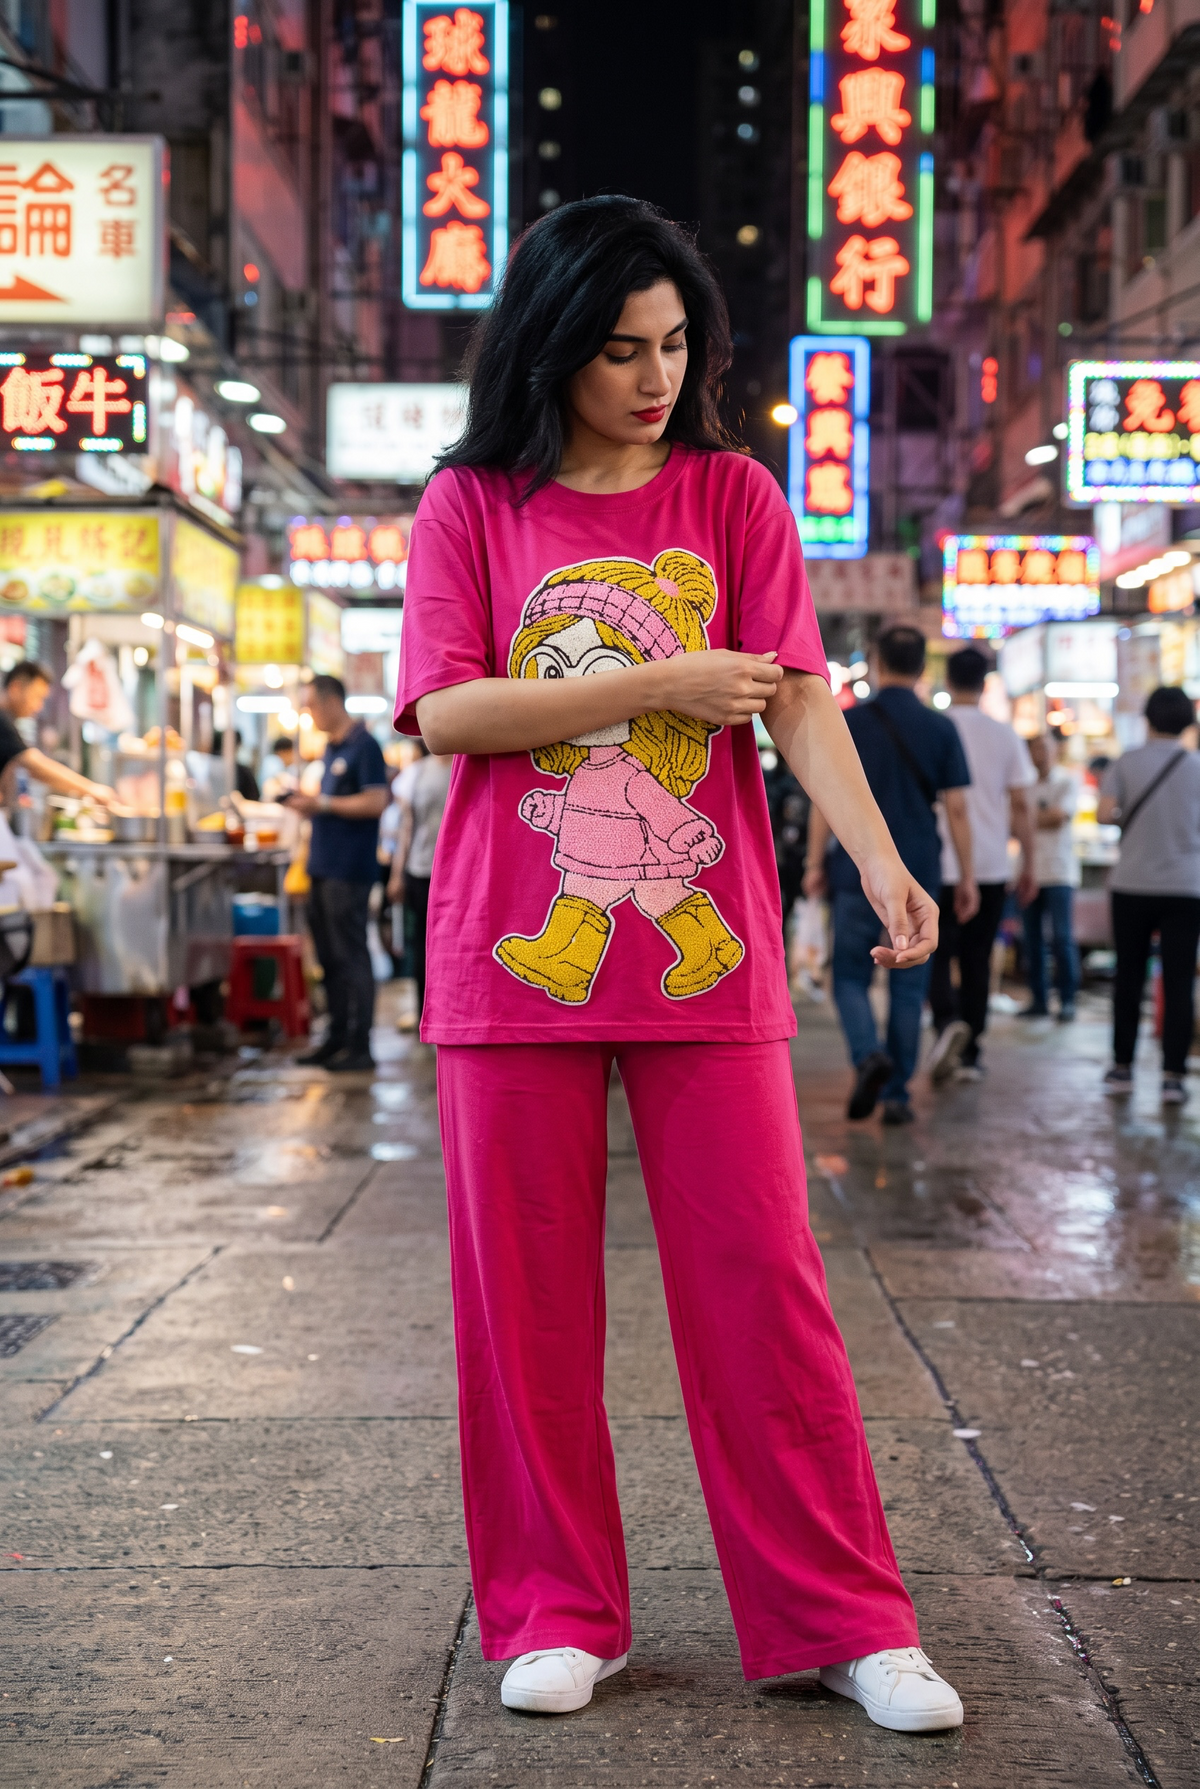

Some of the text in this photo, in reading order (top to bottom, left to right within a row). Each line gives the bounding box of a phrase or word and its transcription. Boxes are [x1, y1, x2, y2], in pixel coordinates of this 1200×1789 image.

[0, 162, 75, 258] 論
[98, 164, 138, 259] 名車
[0, 366, 132, 436] 飯牛
